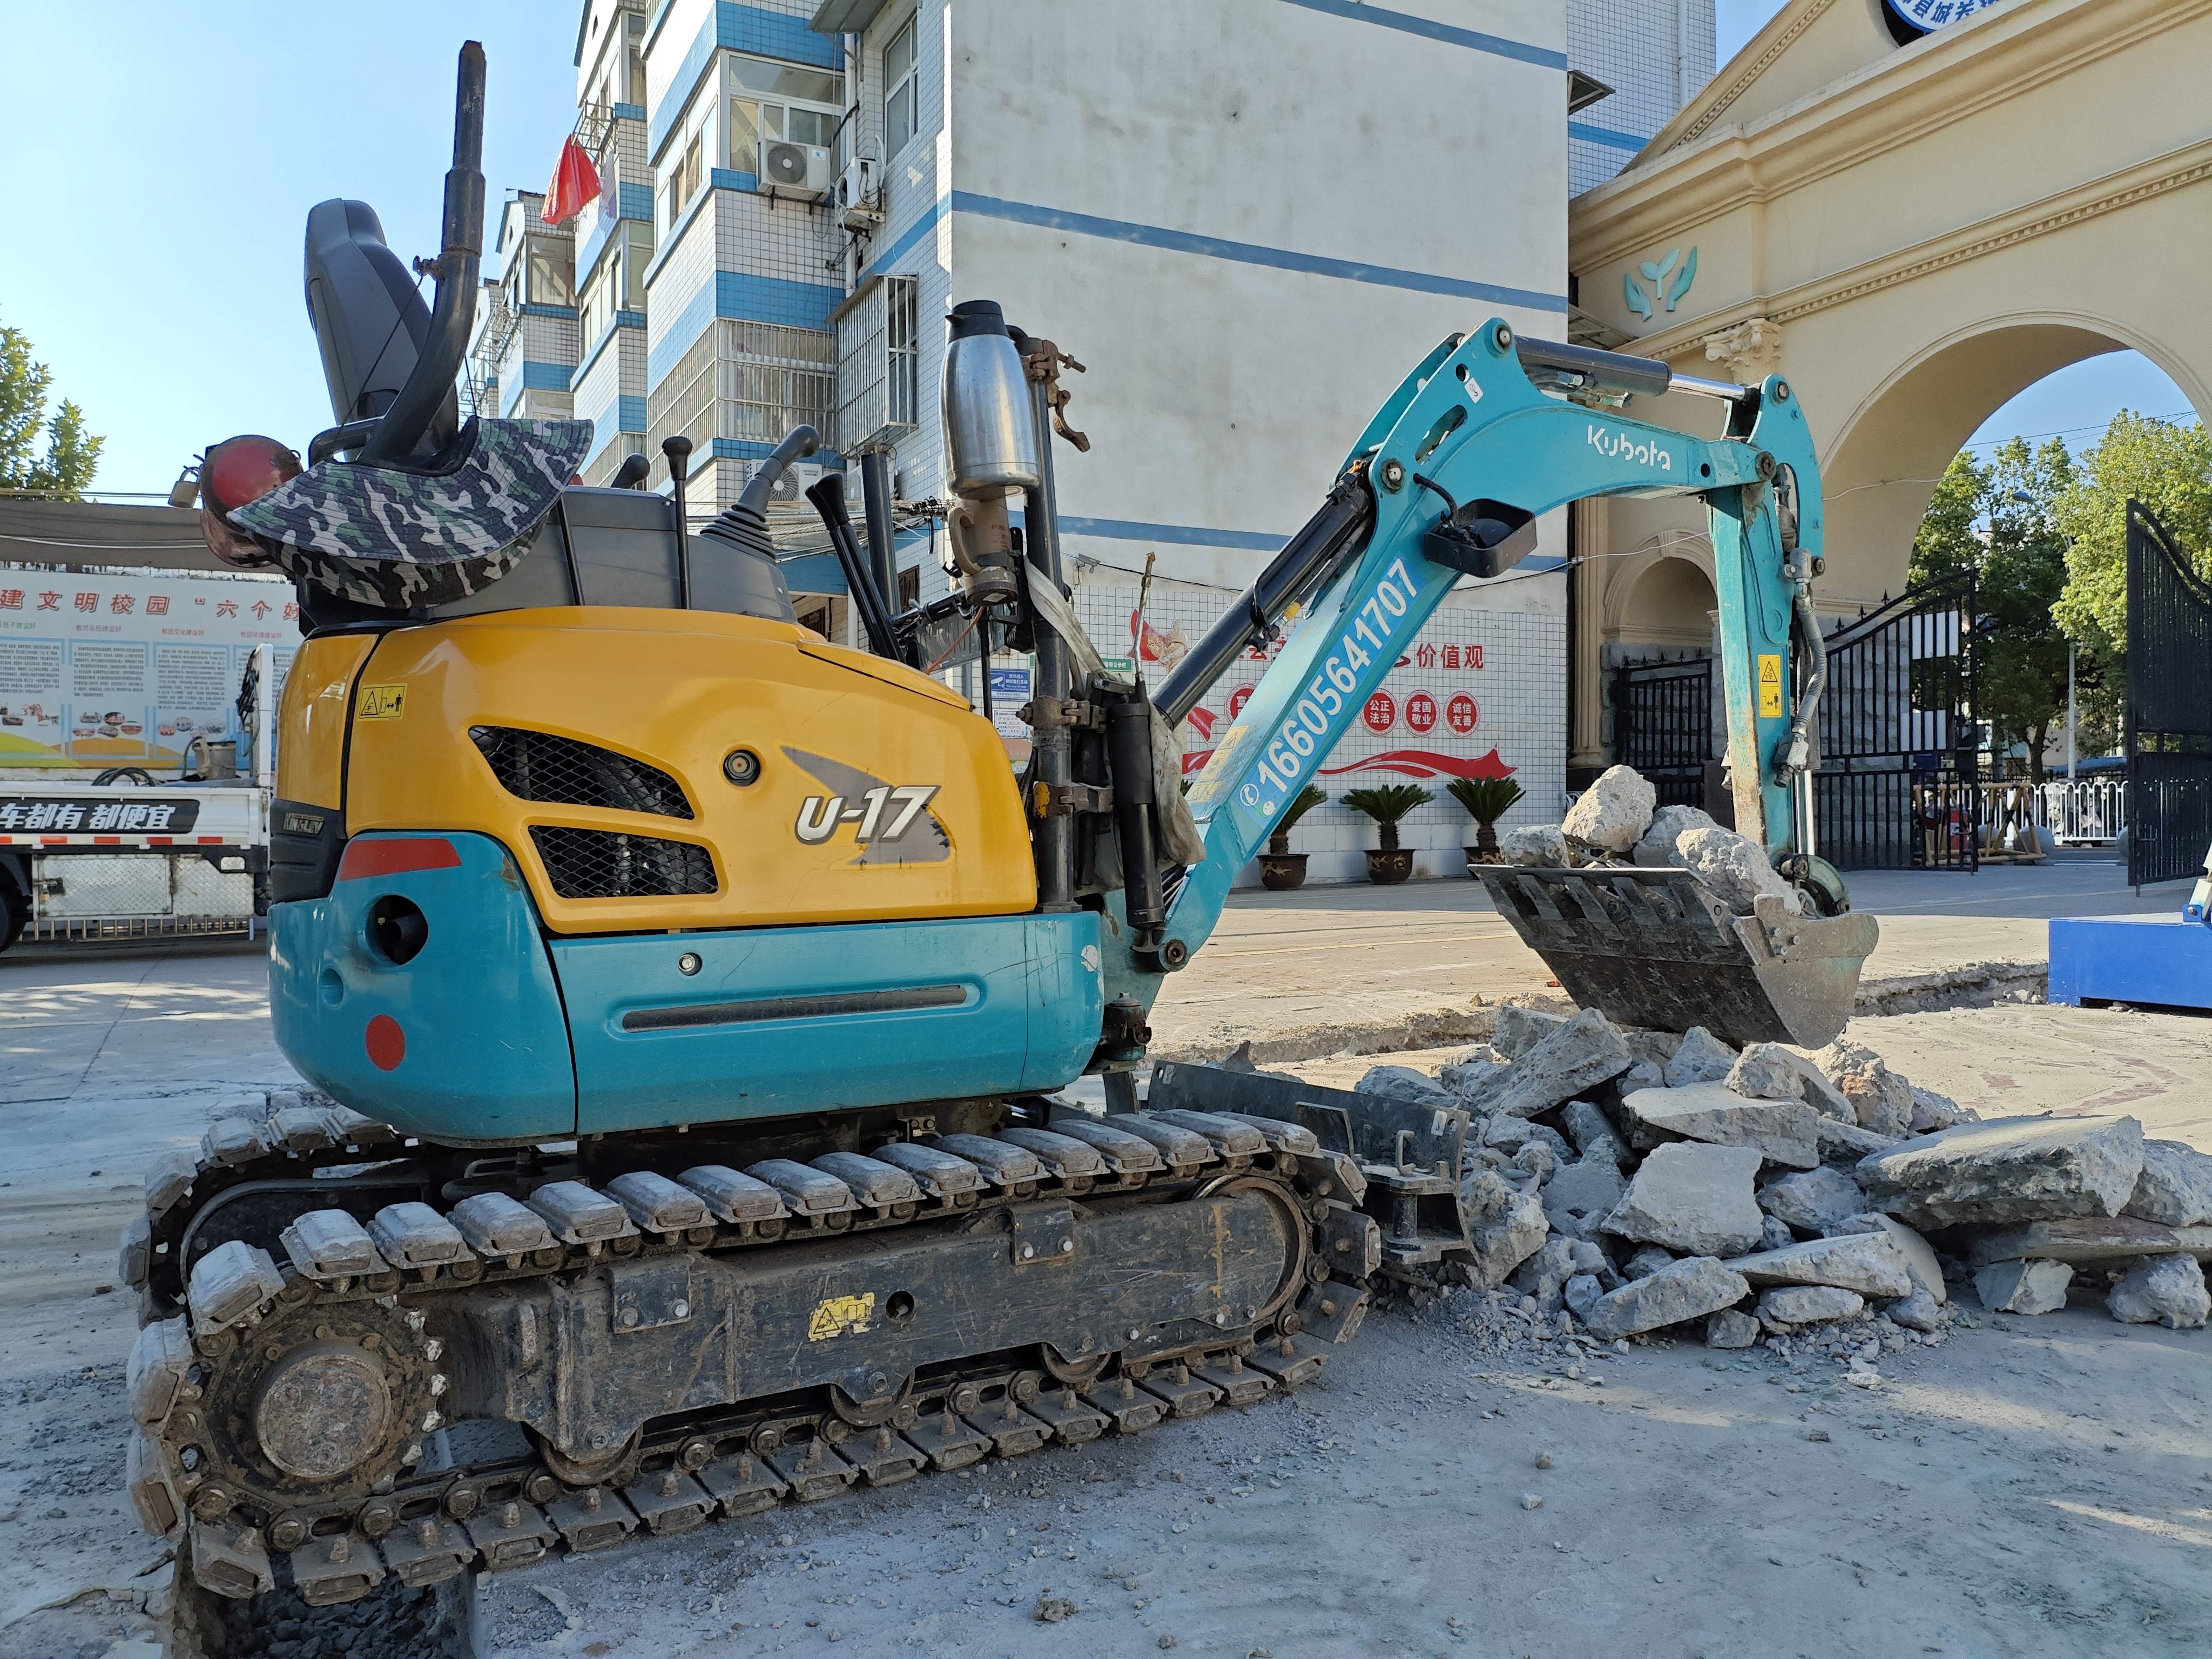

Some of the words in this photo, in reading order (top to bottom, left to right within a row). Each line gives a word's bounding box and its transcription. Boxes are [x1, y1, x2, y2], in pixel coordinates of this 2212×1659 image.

[1587, 424, 1670, 470] Kubota
[161, 628, 204, 637] 校园文化建设好
[1257, 558, 1418, 793] 16605641707
[1370, 700, 1391, 712] 公正
[1411, 702, 1432, 713] 爱国
[1452, 703, 1472, 714] 诚信
[1370, 712, 1390, 725] 法治
[1411, 713, 1432, 725] 敬业
[1452, 715, 1472, 726] 友善
[0, 802, 87, 830] 车都有
[89, 804, 176, 830] 都便宜
[795, 785, 940, 844] U-17
